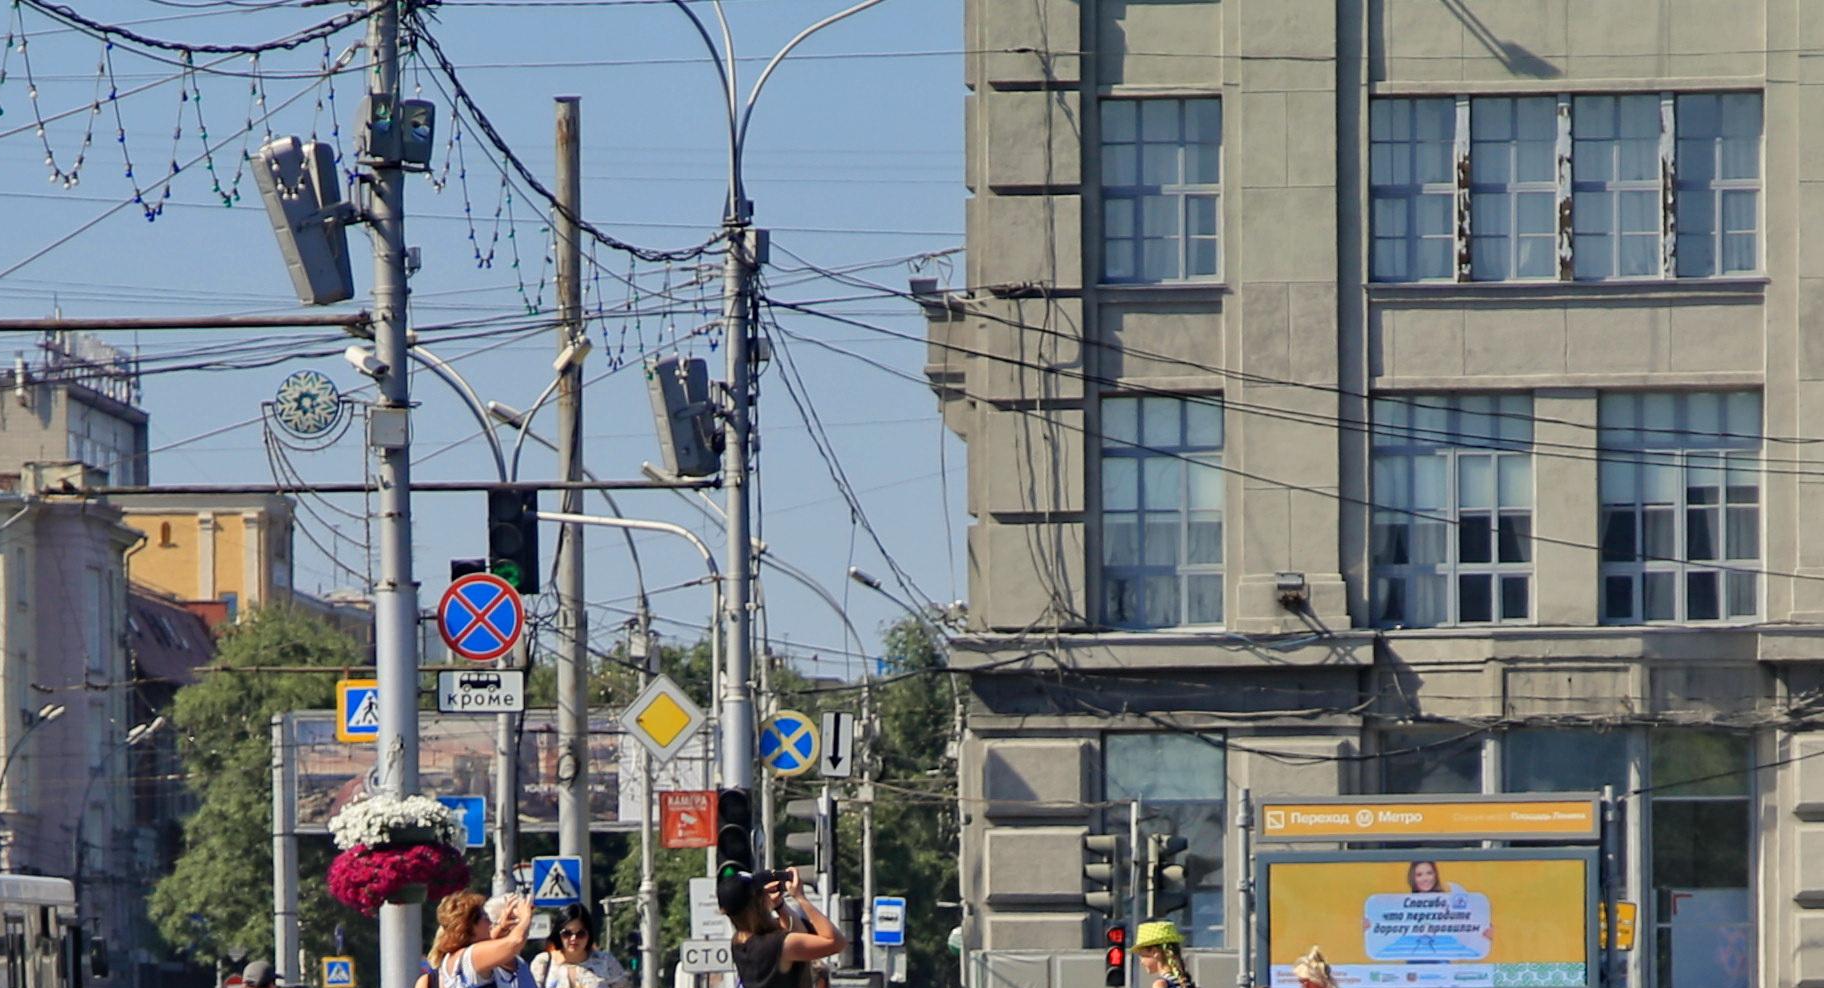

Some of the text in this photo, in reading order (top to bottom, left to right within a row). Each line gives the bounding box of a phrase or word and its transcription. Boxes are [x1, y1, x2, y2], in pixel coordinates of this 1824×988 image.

[447, 693, 514, 709] кроме
[1291, 812, 1350, 825] Переход
[1378, 811, 1423, 825] Метро
[1406, 908, 1471, 923] переходите
[686, 948, 729, 965] СТО
